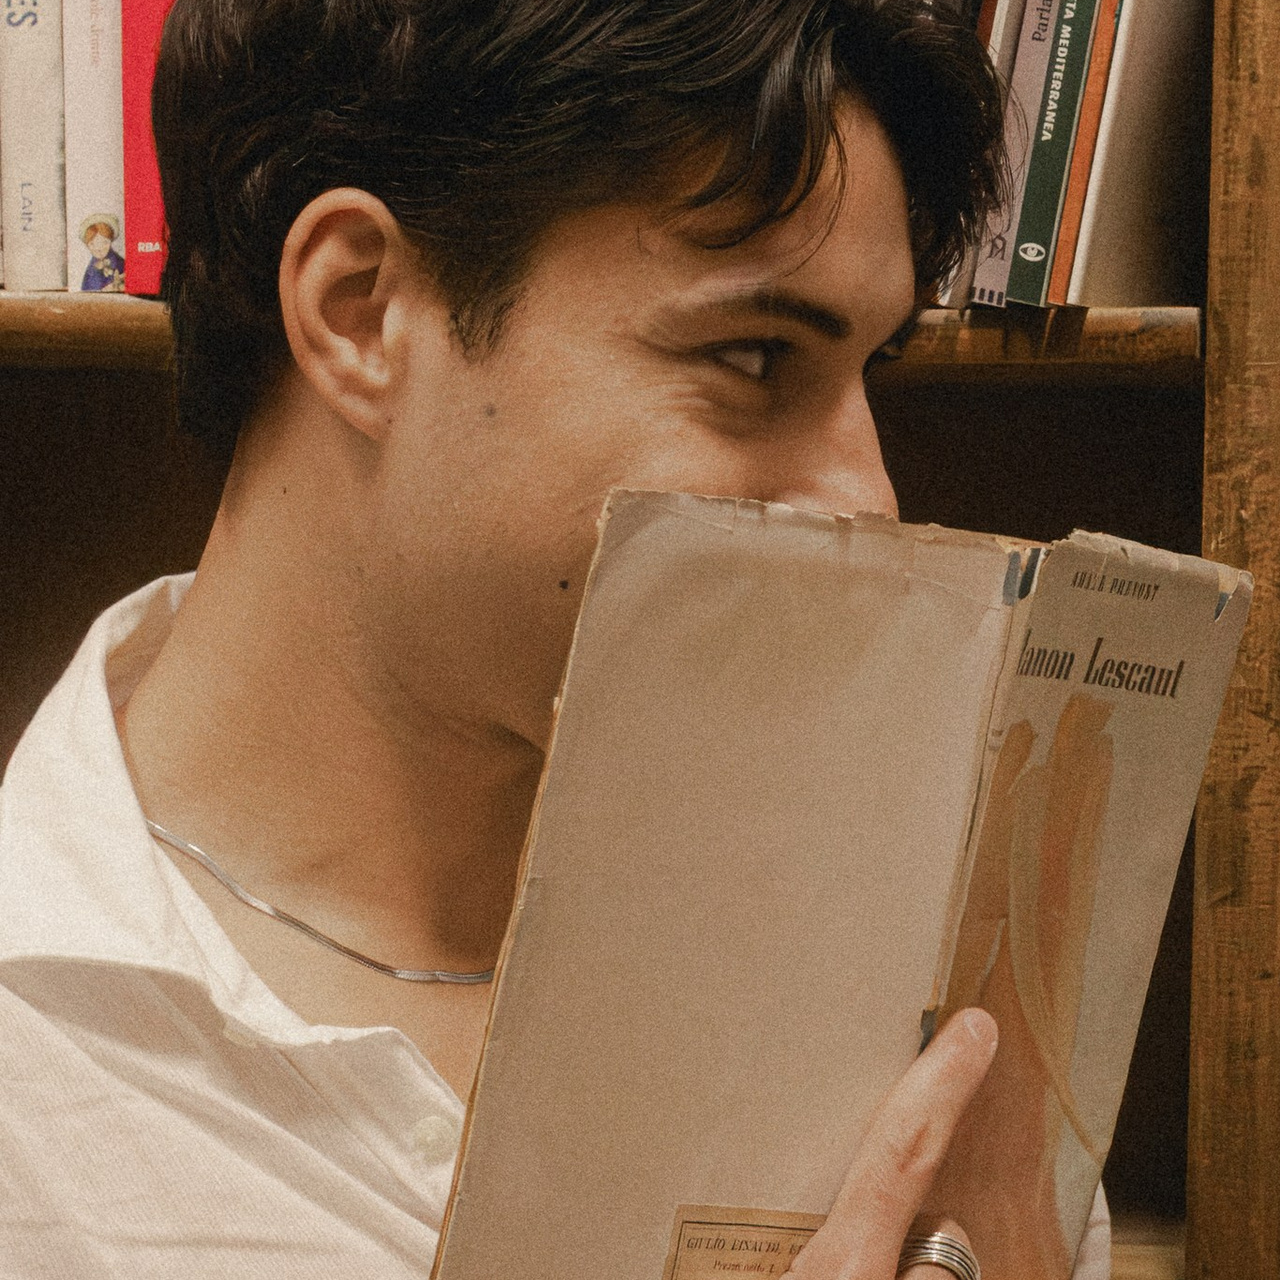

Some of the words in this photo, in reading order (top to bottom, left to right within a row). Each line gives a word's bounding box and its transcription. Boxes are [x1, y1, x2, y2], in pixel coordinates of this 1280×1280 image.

[1040, 23, 1073, 142] MEDITERRANEA
[19, 182, 34, 232] LAIN
[137, 242, 161, 252] RBA
[1083, 636, 1185, 700] Lescaut
